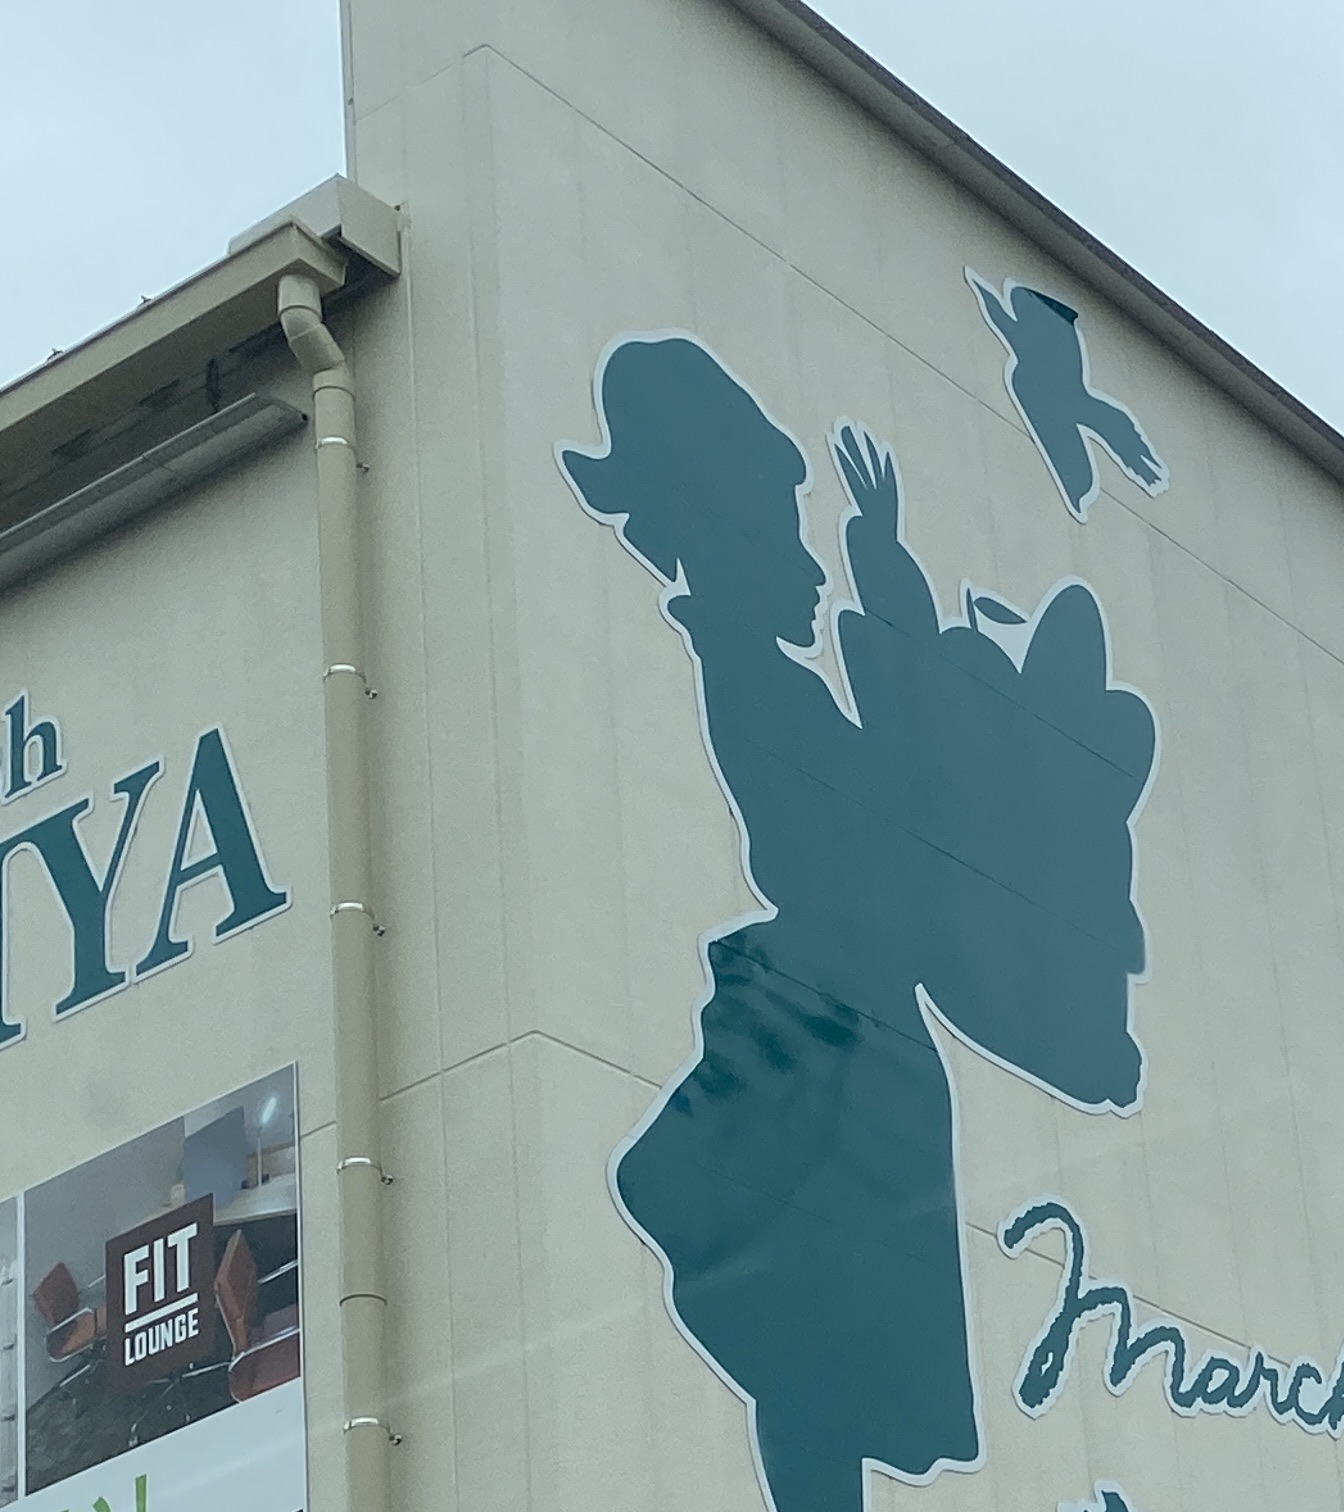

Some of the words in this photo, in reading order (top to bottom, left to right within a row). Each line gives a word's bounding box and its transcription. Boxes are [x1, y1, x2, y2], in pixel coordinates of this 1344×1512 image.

[0, 728, 288, 1048] YA
[122, 1222, 198, 1316] FIT
[123, 1307, 199, 1367] LOUNGE
